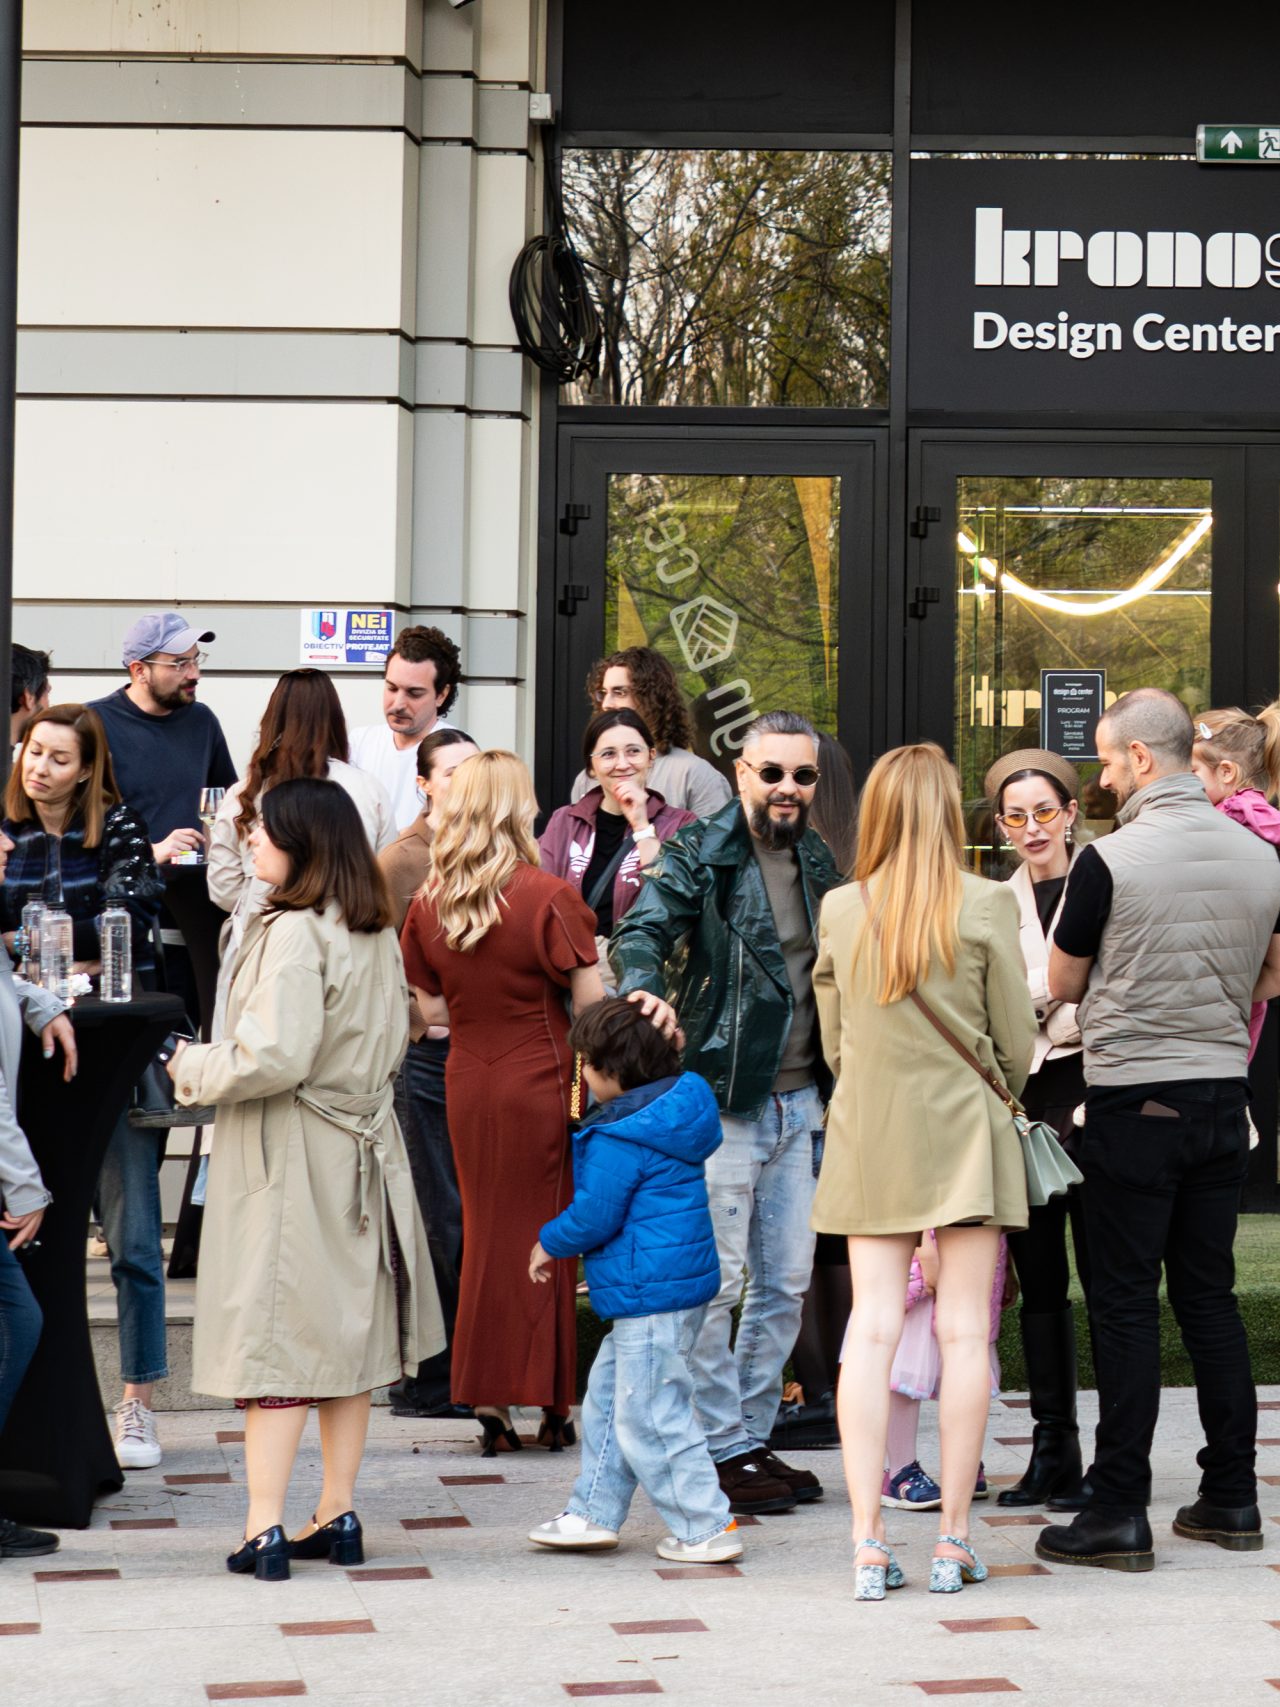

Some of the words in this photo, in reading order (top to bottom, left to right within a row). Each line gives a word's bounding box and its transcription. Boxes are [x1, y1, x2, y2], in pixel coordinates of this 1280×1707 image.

[973, 311, 1122, 359] Design
[303, 642, 344, 650] OBIECTIV
[346, 643, 390, 651] PROTEJAT
